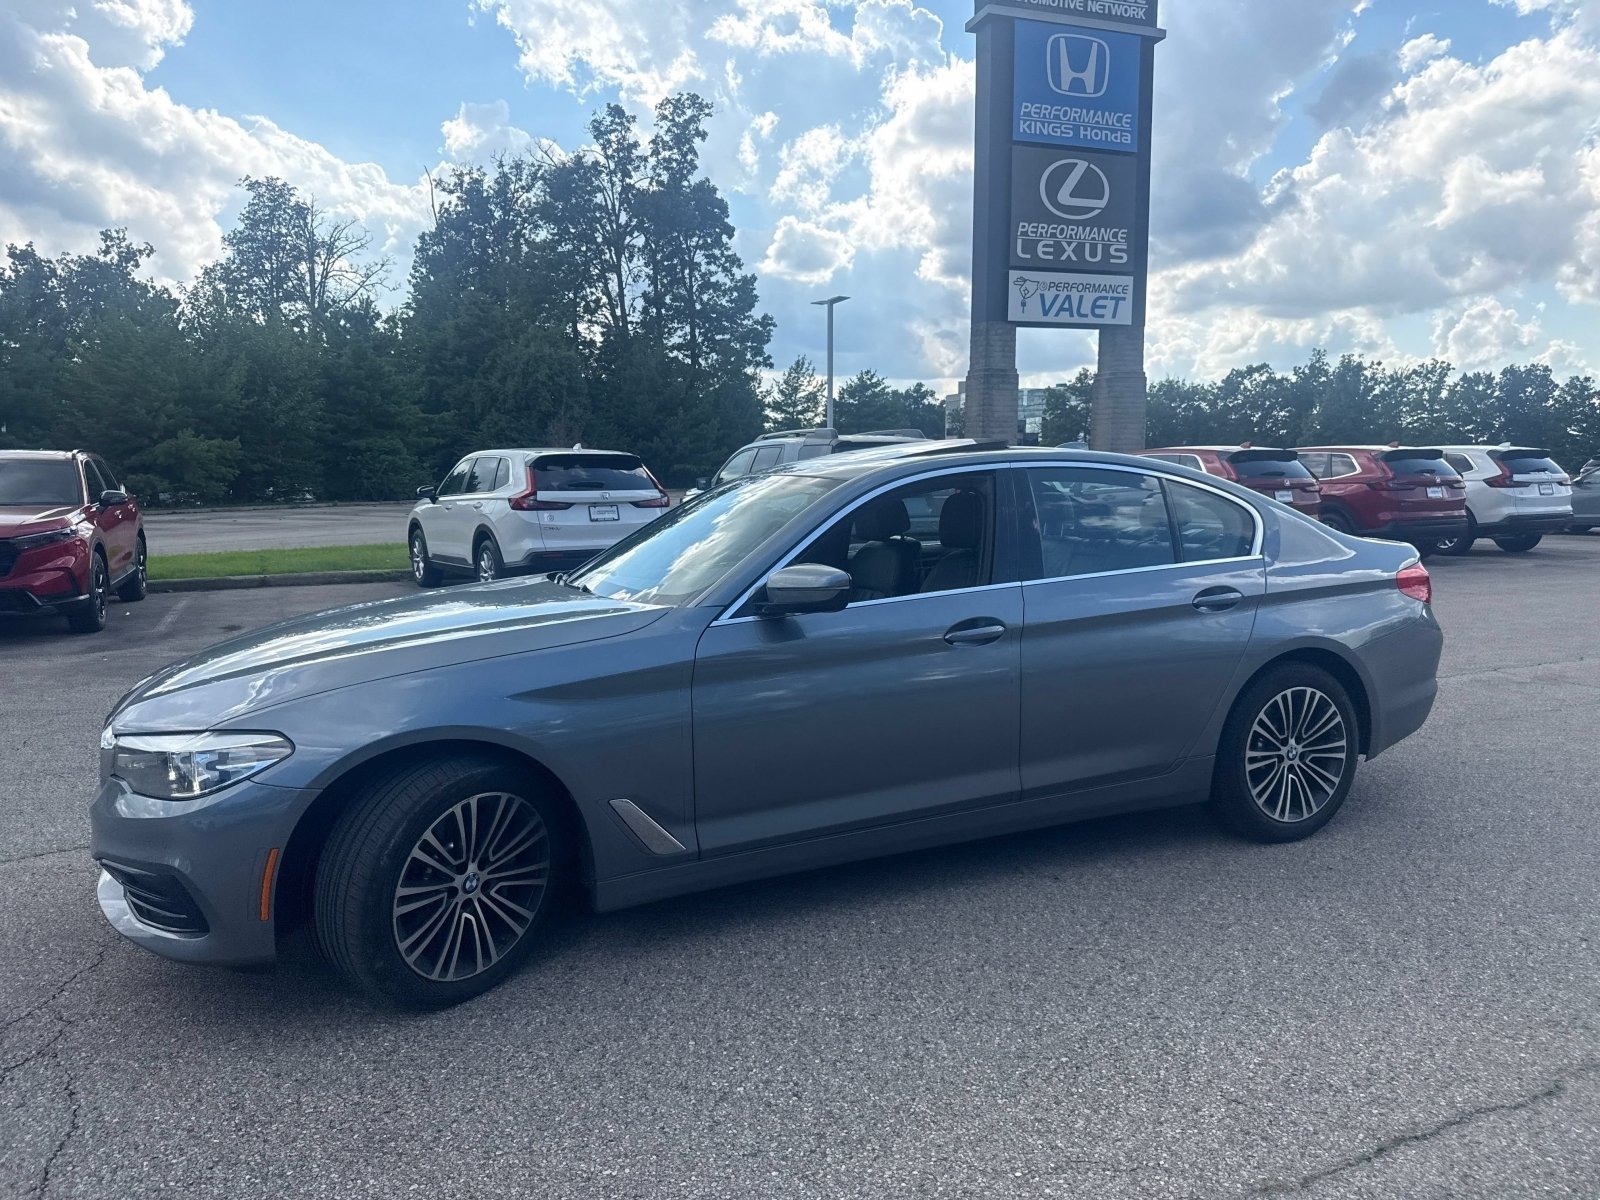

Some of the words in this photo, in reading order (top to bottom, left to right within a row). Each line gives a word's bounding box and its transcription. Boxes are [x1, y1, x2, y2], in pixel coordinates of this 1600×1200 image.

[1087, 0, 1146, 20] NETWORK
[1020, 102, 1132, 128] PERFORMANCE
[1020, 120, 1074, 138] KINGS
[1080, 126, 1132, 144] Honda
[1017, 222, 1128, 243] PERFORMANCE
[1016, 238, 1128, 264] LEXUS
[1047, 281, 1129, 295] PERFORMANCE
[1039, 293, 1127, 320] VALET
